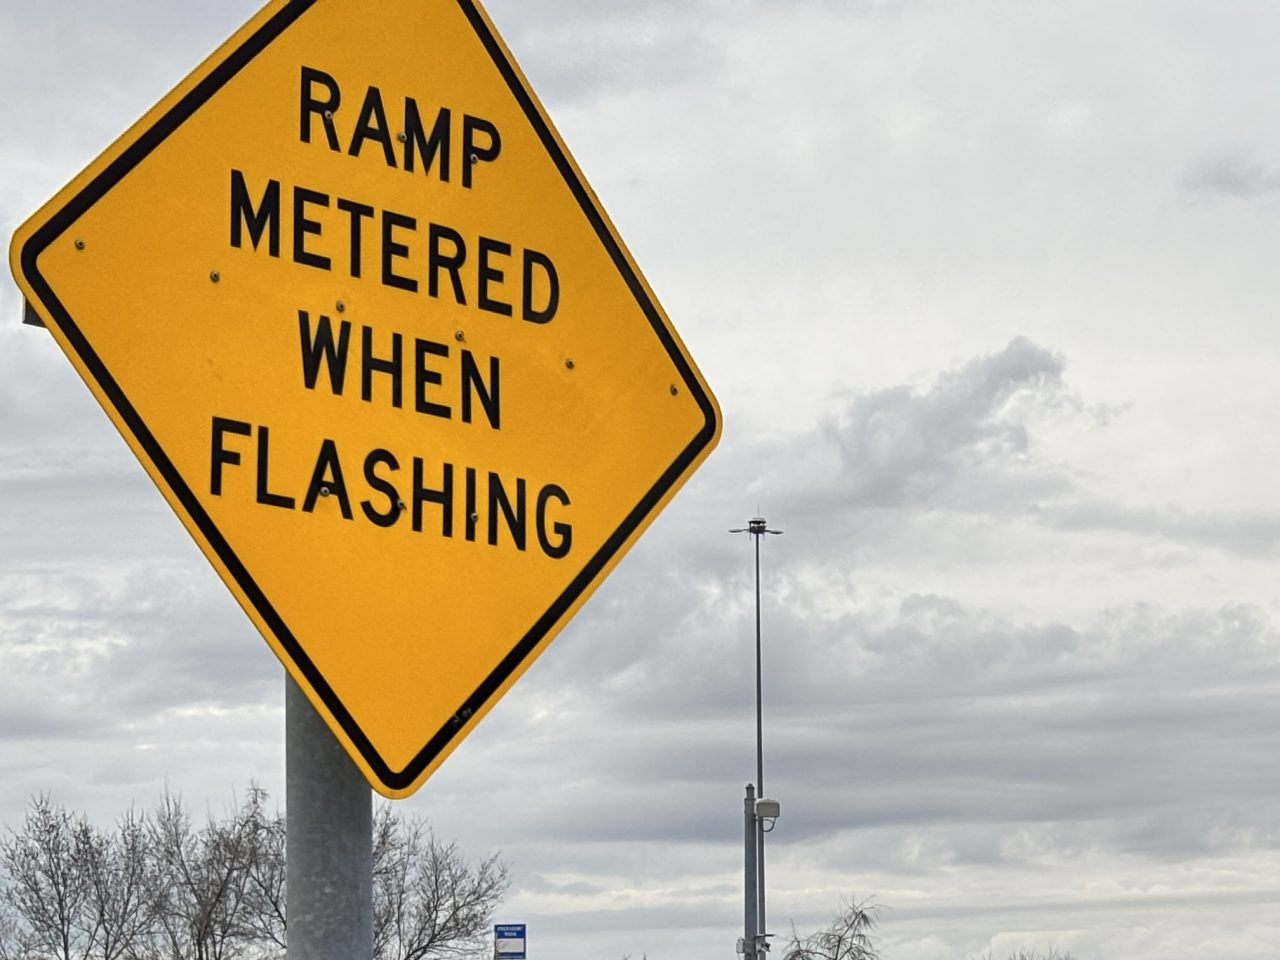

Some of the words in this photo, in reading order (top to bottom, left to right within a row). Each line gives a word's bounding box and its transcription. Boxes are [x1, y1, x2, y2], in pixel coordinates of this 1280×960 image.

[300, 65, 502, 189] RAMP
[229, 169, 560, 324] METERED
[298, 310, 501, 430] WHEN
[210, 416, 573, 559] FLASHING
